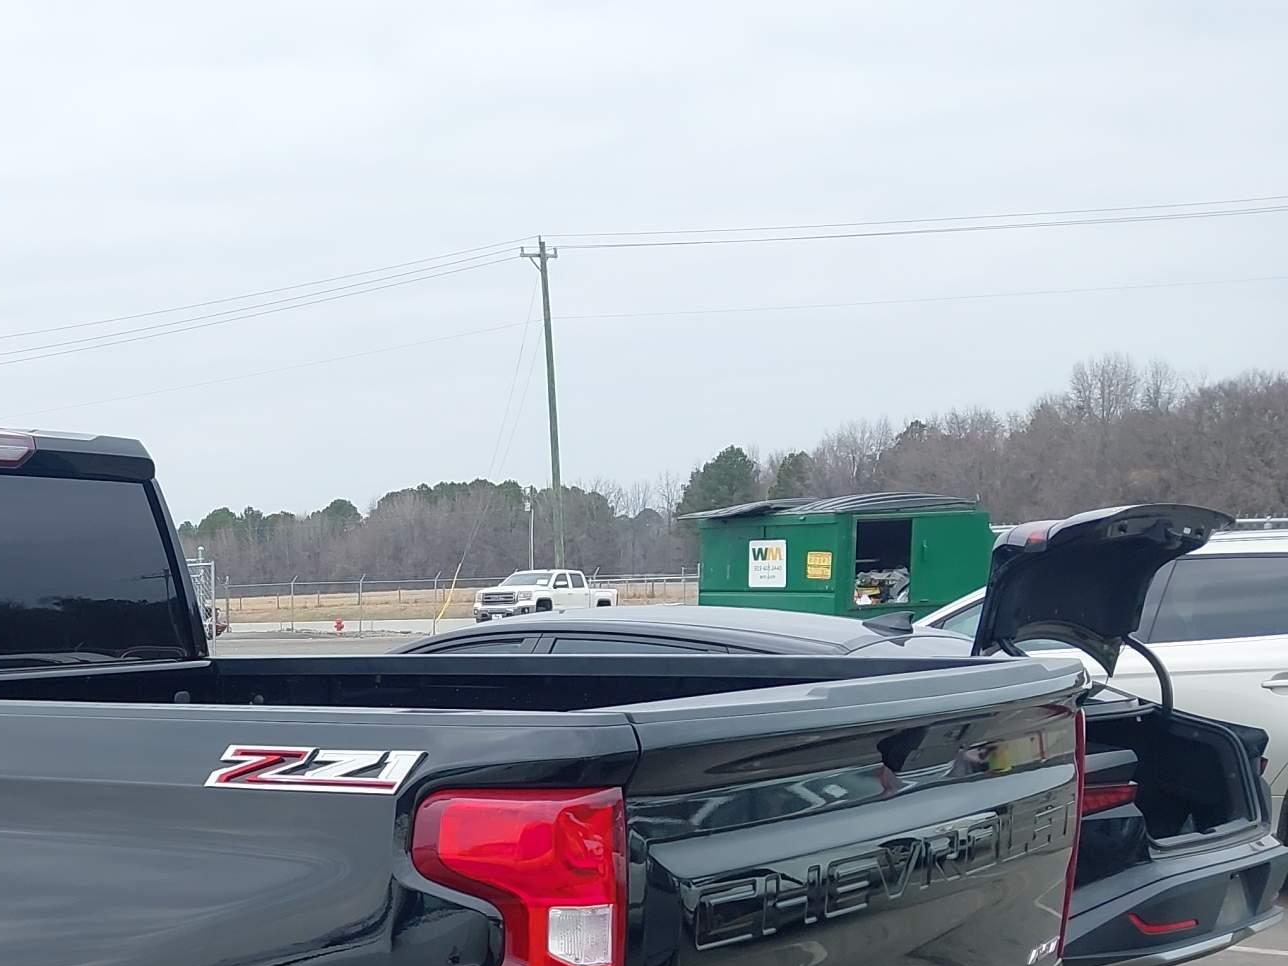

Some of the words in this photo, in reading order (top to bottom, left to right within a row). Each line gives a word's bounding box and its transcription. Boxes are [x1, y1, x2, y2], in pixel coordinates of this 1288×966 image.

[752, 546, 782, 561] WM
[204, 745, 424, 795] Z71
[697, 801, 1074, 950] CHEVROLET
